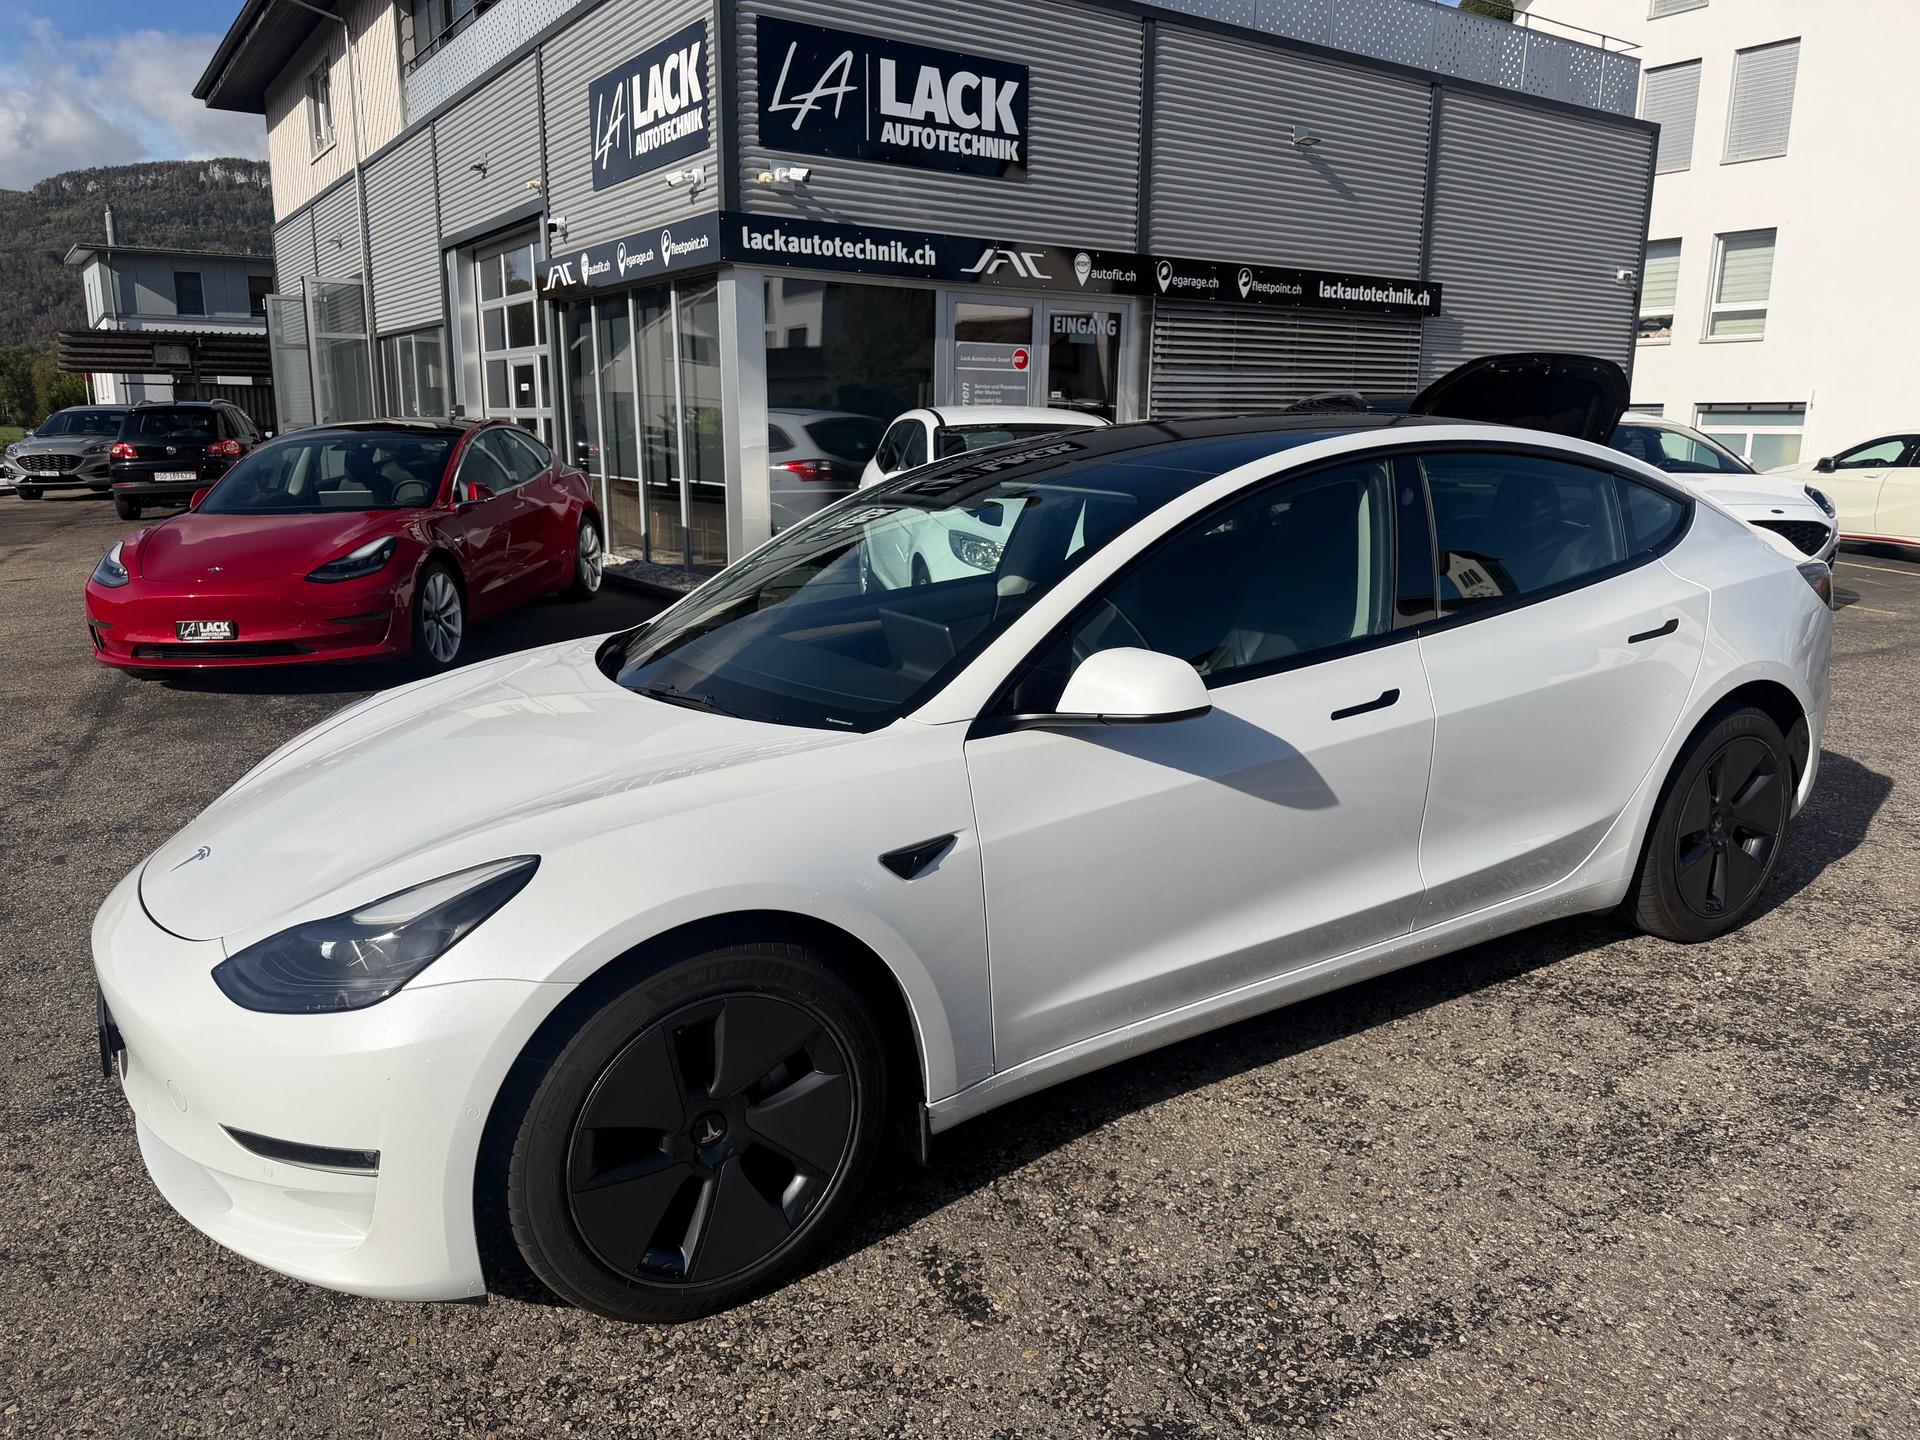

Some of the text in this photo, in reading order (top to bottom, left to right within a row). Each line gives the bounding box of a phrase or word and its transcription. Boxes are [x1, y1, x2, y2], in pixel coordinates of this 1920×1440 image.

[632, 40, 703, 130] LACK
[879, 57, 1020, 136] LACK
[635, 106, 704, 156] AUTOTECHNIK
[880, 121, 1020, 162] AUTOTECHNIK
[671, 234, 709, 256] fleetpoint.ch
[742, 225, 937, 267] lackautotechnik.ch
[588, 260, 611, 277] autofit.ch
[625, 249, 655, 269] egarage.ch
[1091, 268, 1138, 283] autofit.ch
[1172, 275, 1220, 290] egarage.ch
[1251, 281, 1303, 296] fleetpoint.ch
[1317, 279, 1432, 307] lackautotechnik.ch
[1053, 316, 1117, 336] EINGANG
[199, 621, 231, 633] LACK
